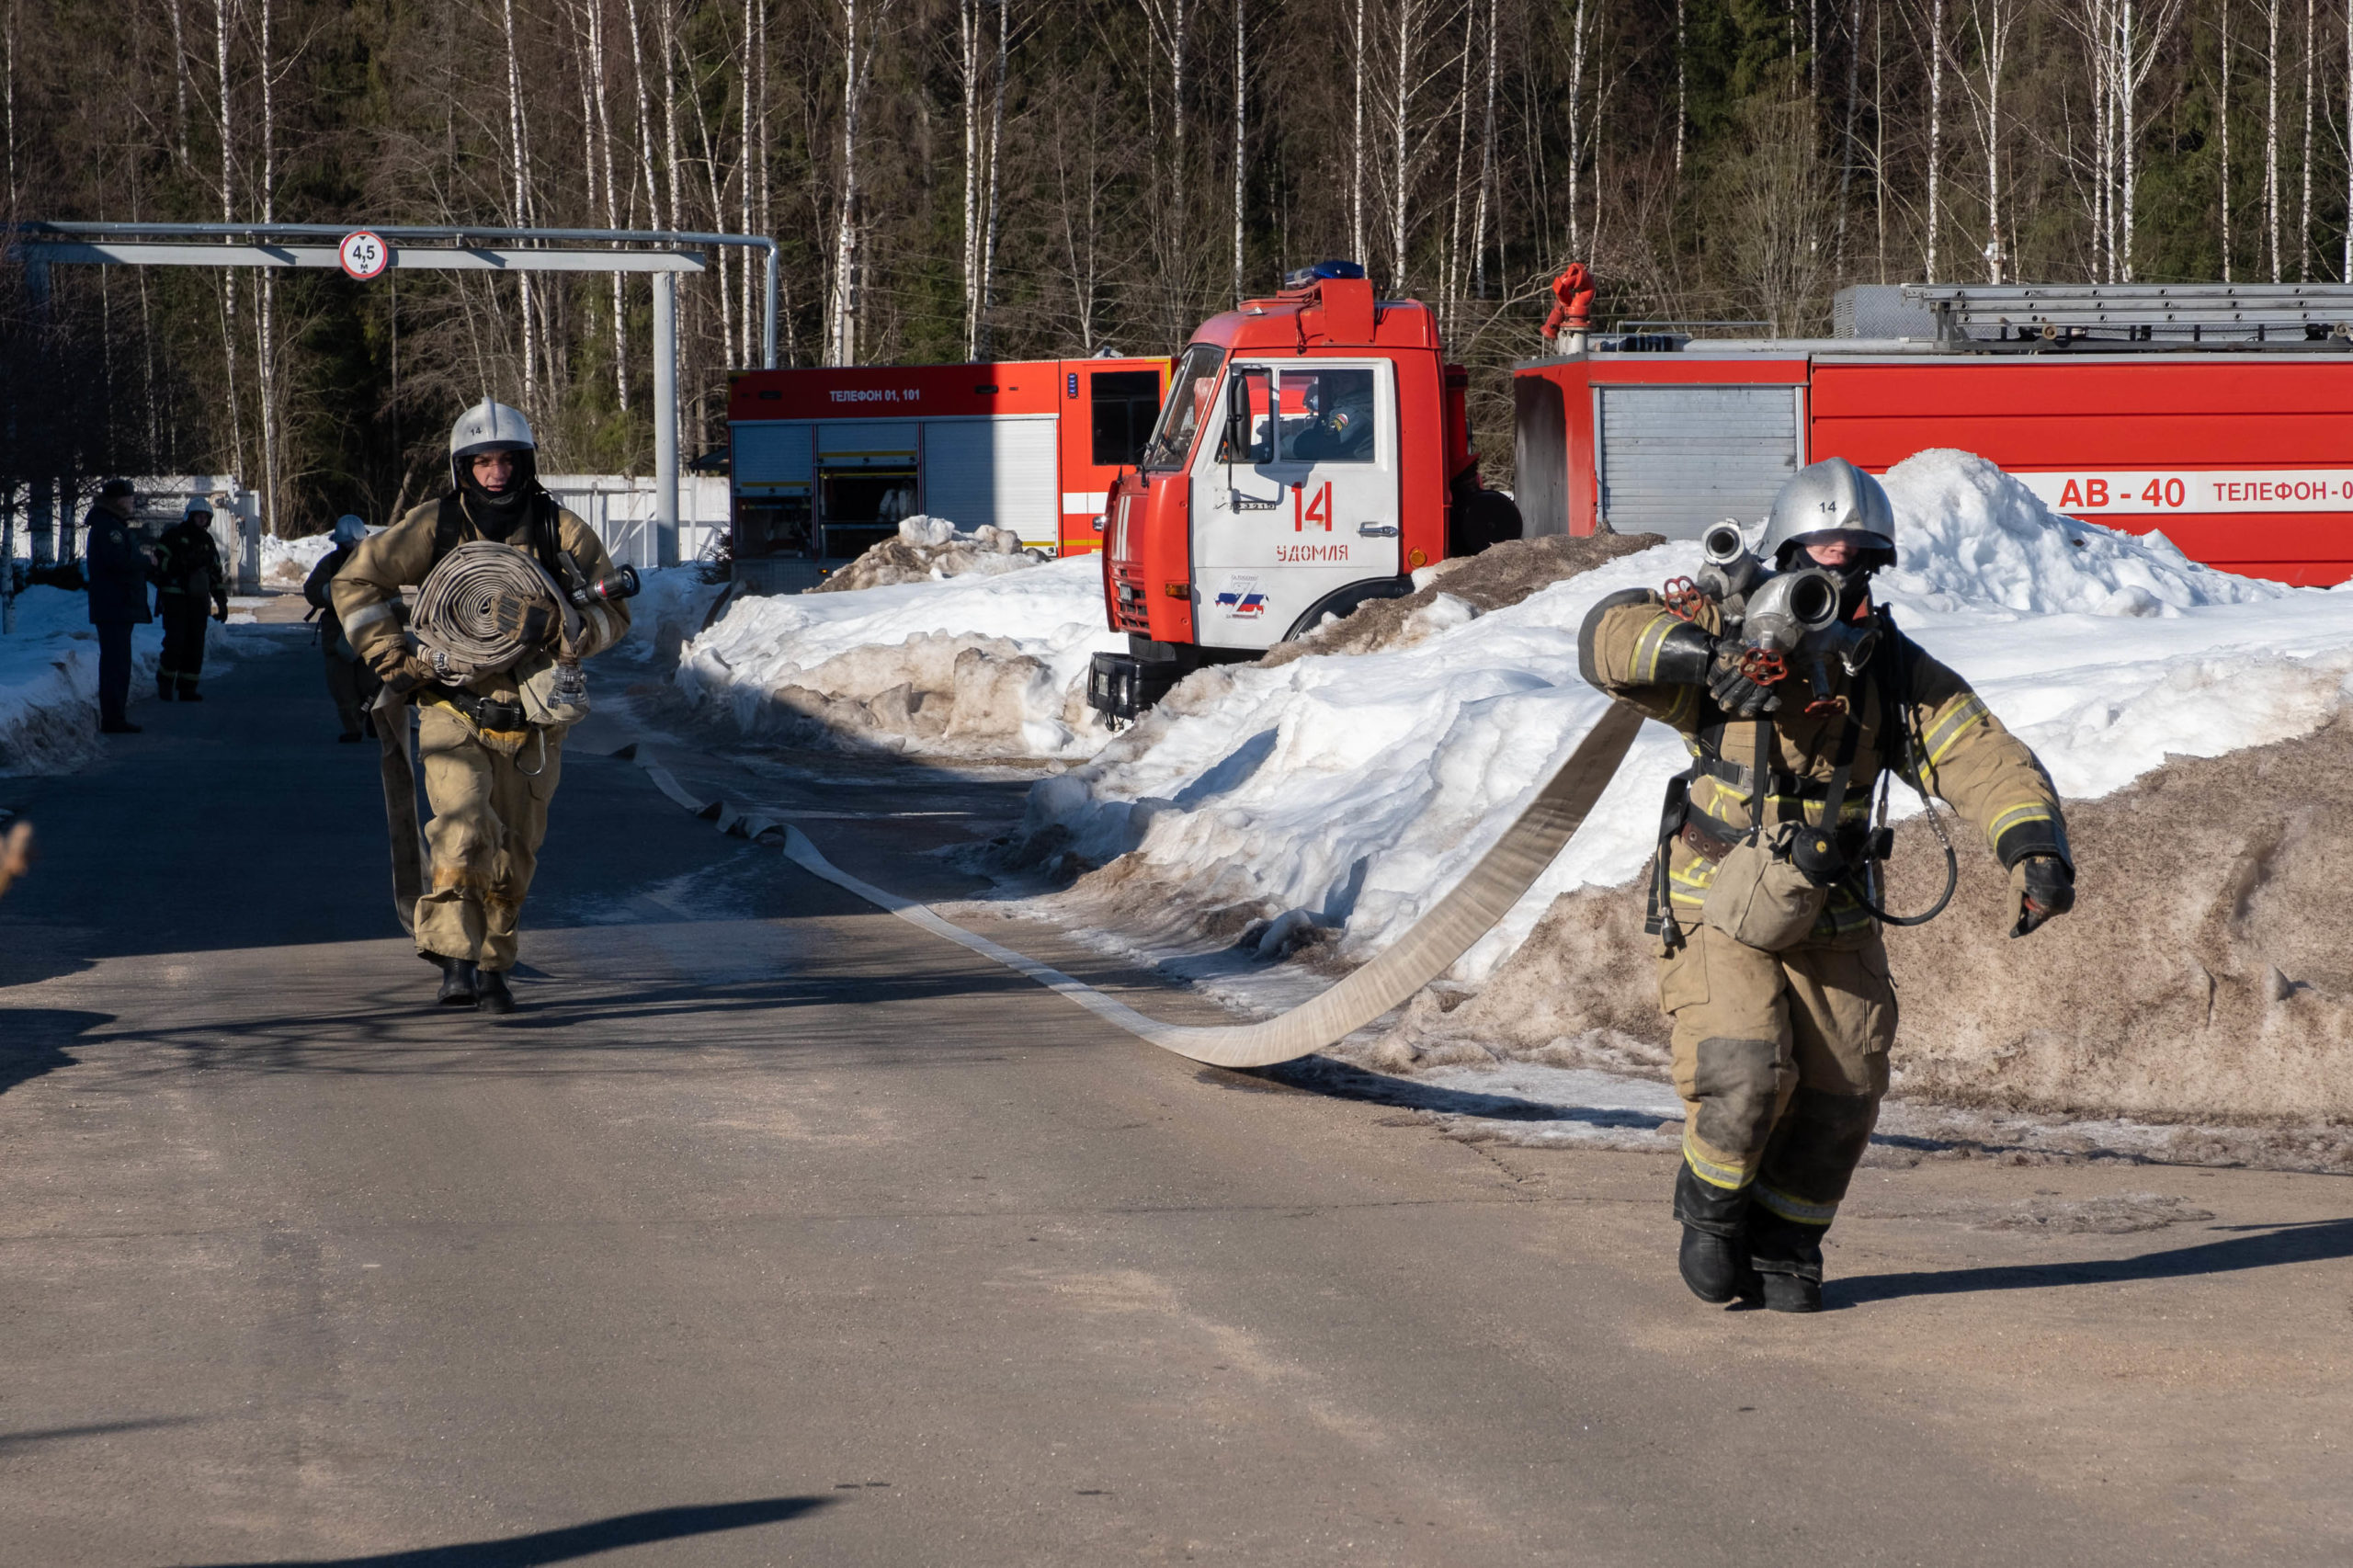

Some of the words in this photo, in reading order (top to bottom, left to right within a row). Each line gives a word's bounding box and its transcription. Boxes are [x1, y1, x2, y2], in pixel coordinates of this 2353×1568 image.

[353, 244, 375, 263] 4,5
[828, 390, 882, 403] ТЕЛЕФОН
[885, 390, 901, 403] 01,
[903, 389, 920, 402] 101
[471, 426, 483, 437] 14
[2059, 479, 2109, 507] АВ
[2142, 478, 2185, 507] 40
[1290, 481, 1332, 532] 14
[1819, 501, 1837, 513] 14
[1277, 545, 1348, 562] УДОМЛЯ
